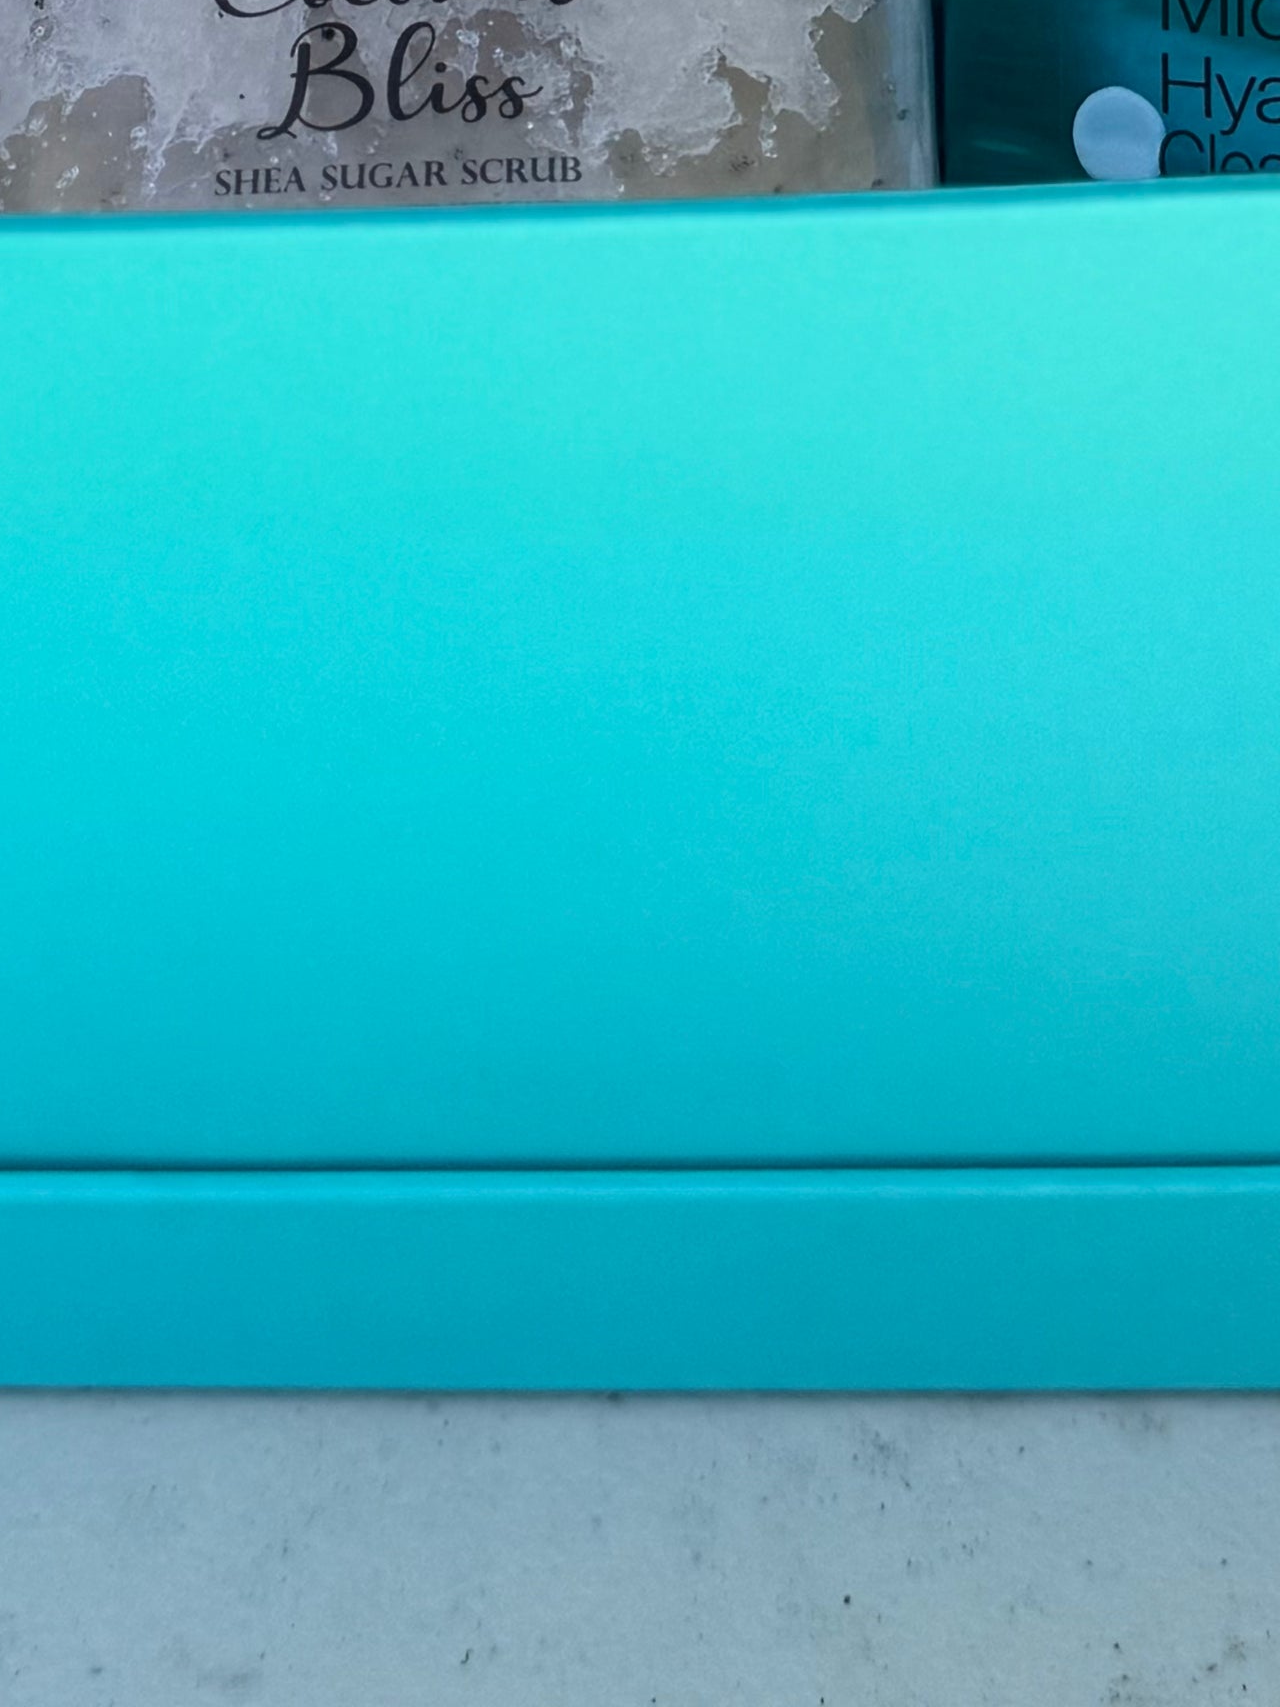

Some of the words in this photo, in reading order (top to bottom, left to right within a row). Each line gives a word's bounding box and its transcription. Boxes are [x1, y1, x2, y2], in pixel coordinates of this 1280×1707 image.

[255, 19, 544, 141] Bliss
[214, 166, 307, 197] SHEA
[319, 159, 448, 192] SUGAR
[460, 156, 583, 187] SCRUB
